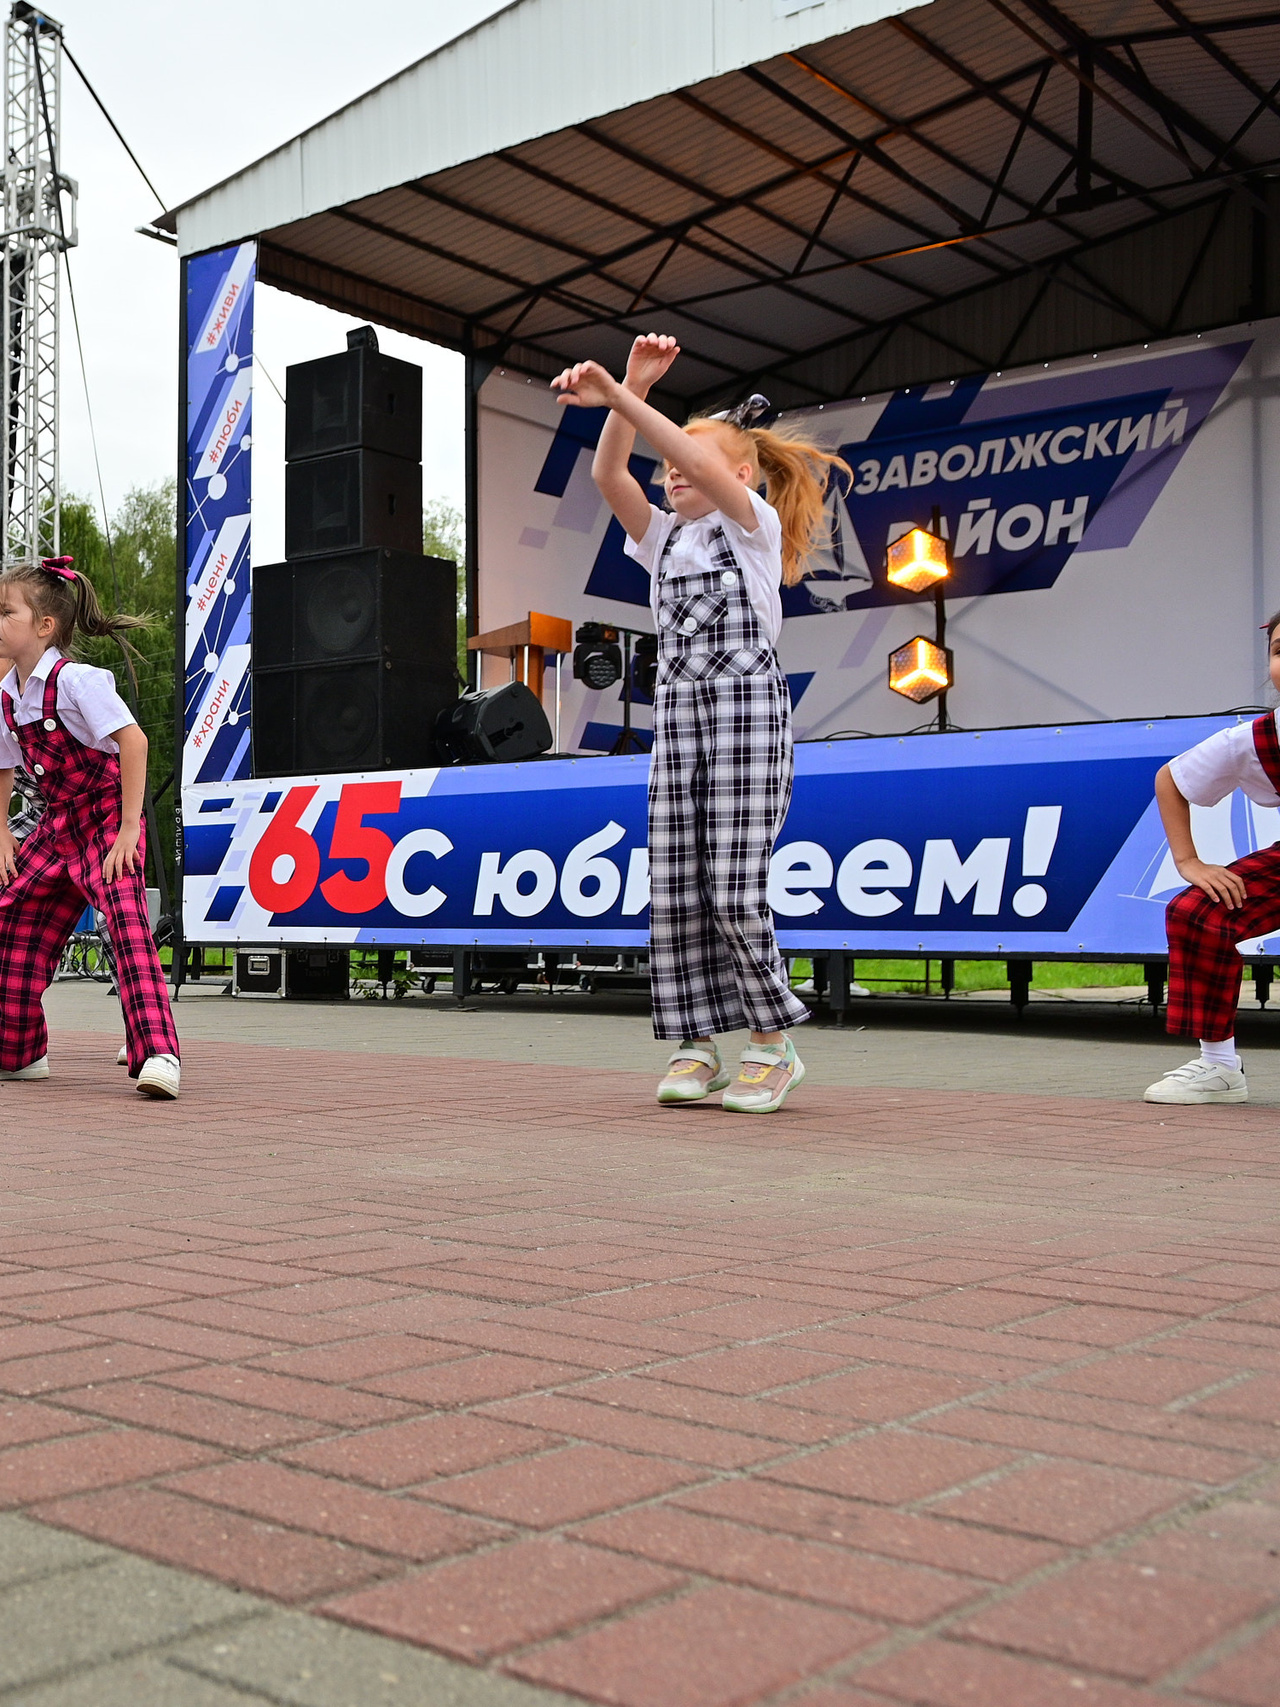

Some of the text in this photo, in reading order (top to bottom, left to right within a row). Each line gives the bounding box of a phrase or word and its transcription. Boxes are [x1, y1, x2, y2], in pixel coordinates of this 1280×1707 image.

[207, 282, 239, 346] #живи
[209, 399, 242, 464] #люби
[855, 399, 1189, 495] ЗАВОЛЖСКИЙ
[882, 494, 1089, 568] ЙОН
[196, 552, 228, 612] #цени
[193, 679, 230, 748] #храни
[249, 781, 402, 914] 65
[473, 806, 1062, 917] юбеем!
